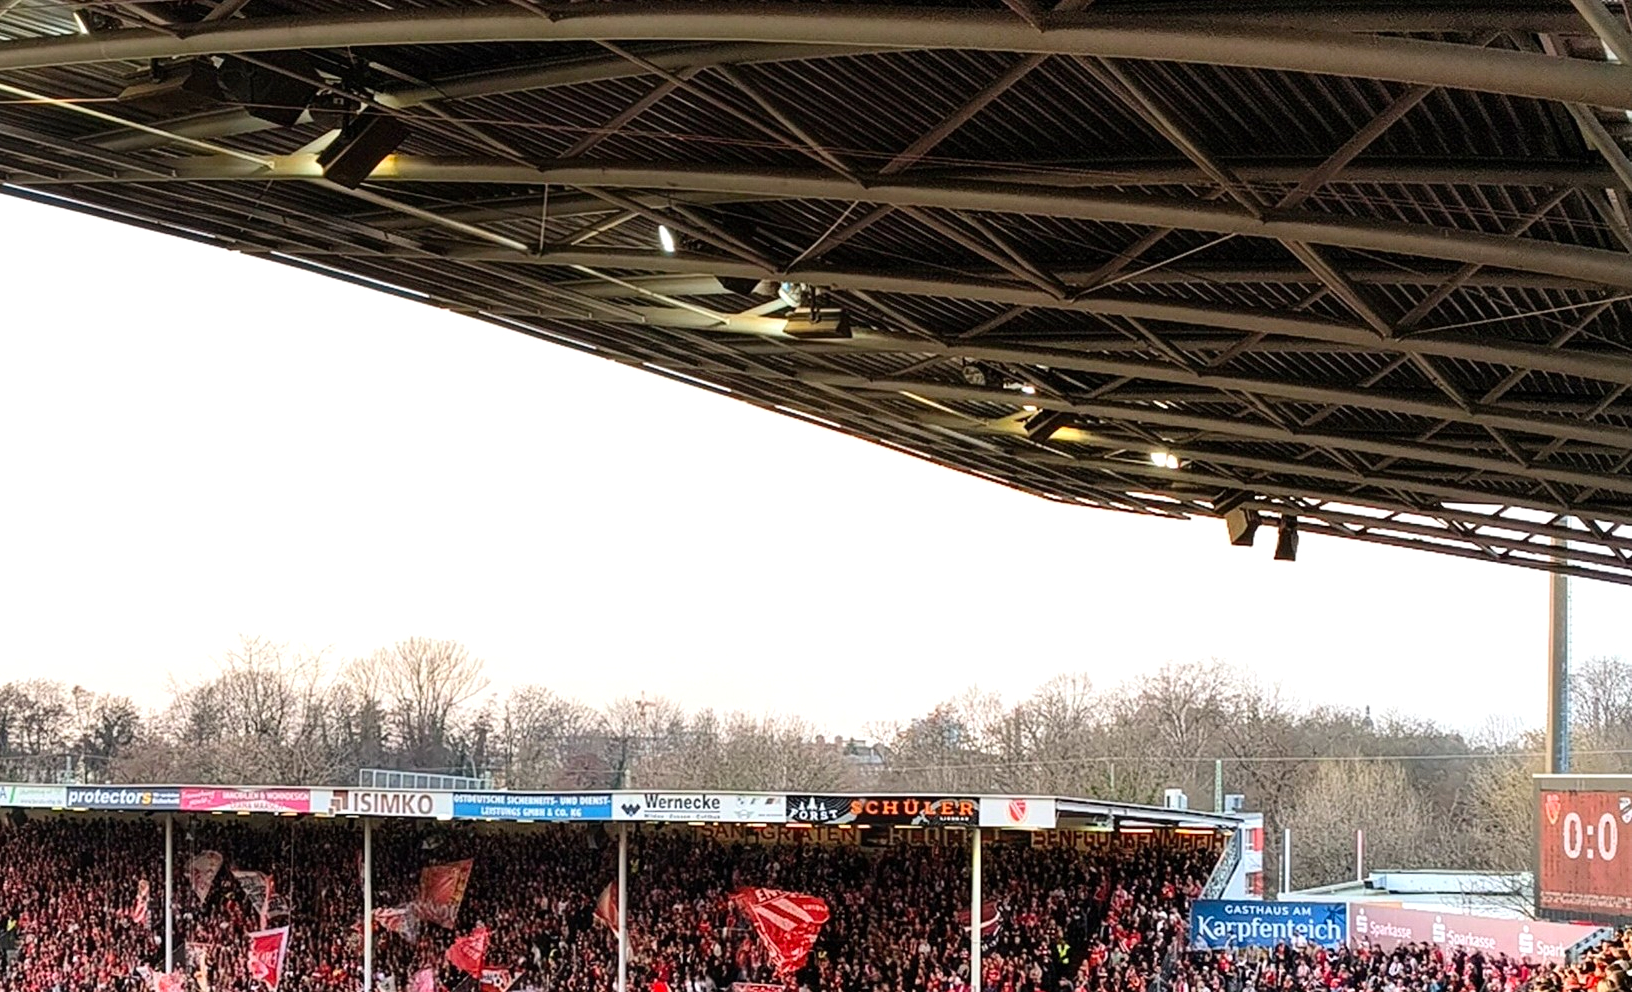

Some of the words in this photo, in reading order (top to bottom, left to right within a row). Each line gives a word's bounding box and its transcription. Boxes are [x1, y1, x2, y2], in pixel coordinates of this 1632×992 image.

[68, 789, 151, 806] protectors
[353, 793, 434, 814] ISIMKO
[453, 795, 505, 804] OSTDEUTSCHE
[506, 795, 558, 805] SICHERHEITS-
[559, 796, 577, 805] UND
[579, 797, 611, 806] DIENST-
[644, 794, 721, 810] Wernecke
[480, 807, 522, 817] LEISTUNGS
[850, 798, 975, 816] SCHÜLER
[1563, 811, 1618, 861] 0:0
[1225, 904, 1290, 917] GASTHAUS
[1293, 906, 1312, 917] AM
[1197, 915, 1342, 947] Karpfenteich
[1368, 921, 1412, 940] Sparkasse
[1446, 930, 1497, 950] Sparkasse
